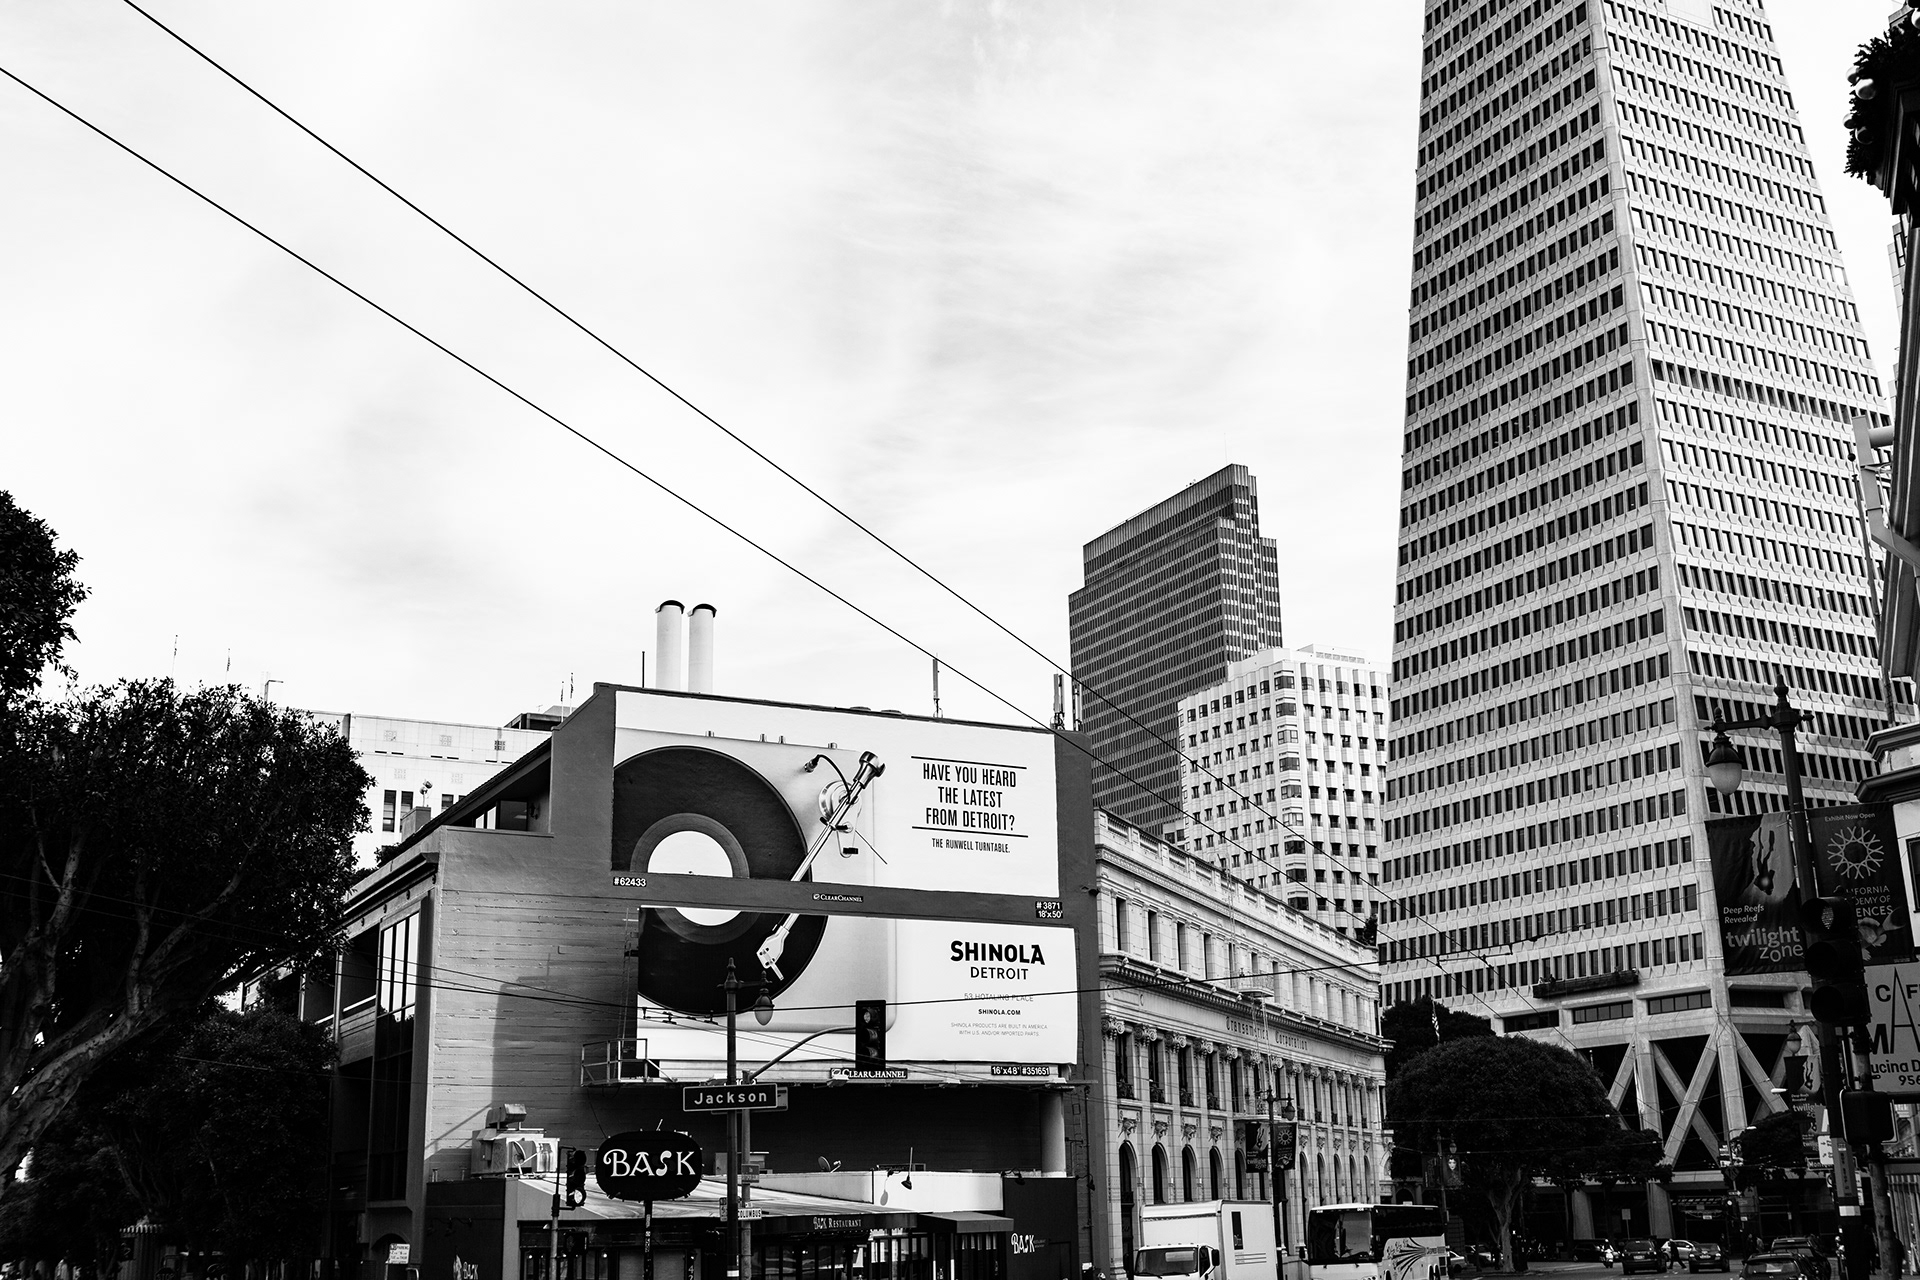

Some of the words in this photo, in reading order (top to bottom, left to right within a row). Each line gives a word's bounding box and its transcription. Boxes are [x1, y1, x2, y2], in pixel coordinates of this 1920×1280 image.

[923, 762, 950, 781] HAVE
[955, 765, 977, 783] YOU
[982, 768, 1016, 787] HEARD
[938, 786, 958, 804] THE
[963, 788, 1003, 808] LATEST
[926, 807, 957, 826] FROM
[962, 810, 1015, 831] DETROIT?
[931, 838, 943, 849] THE
[946, 839, 974, 851] RUNWELL
[975, 841, 1011, 853] TURNTABLE.
[614, 877, 646, 887] #62433
[1845, 885, 1891, 896] FORNIA
[1879, 894, 1891, 903] OF
[1723, 906, 1743, 915] Deep
[1743, 904, 1765, 913] Reefs
[1855, 904, 1893, 917] ENCES
[1724, 914, 1758, 924] Revealed
[1725, 926, 1801, 948] twilight
[950, 940, 1046, 965] SHINOLA
[1758, 944, 1805, 962] zone
[970, 966, 1029, 980] DETROIT
[1021, 1067, 1050, 1076] #351651
[1870, 1059, 1909, 1073] ucina
[694, 1090, 767, 1105] Jackson
[603, 1149, 696, 1177] BASK
[1010, 1232, 1035, 1254] BASK
[463, 1261, 479, 1280] BASK
